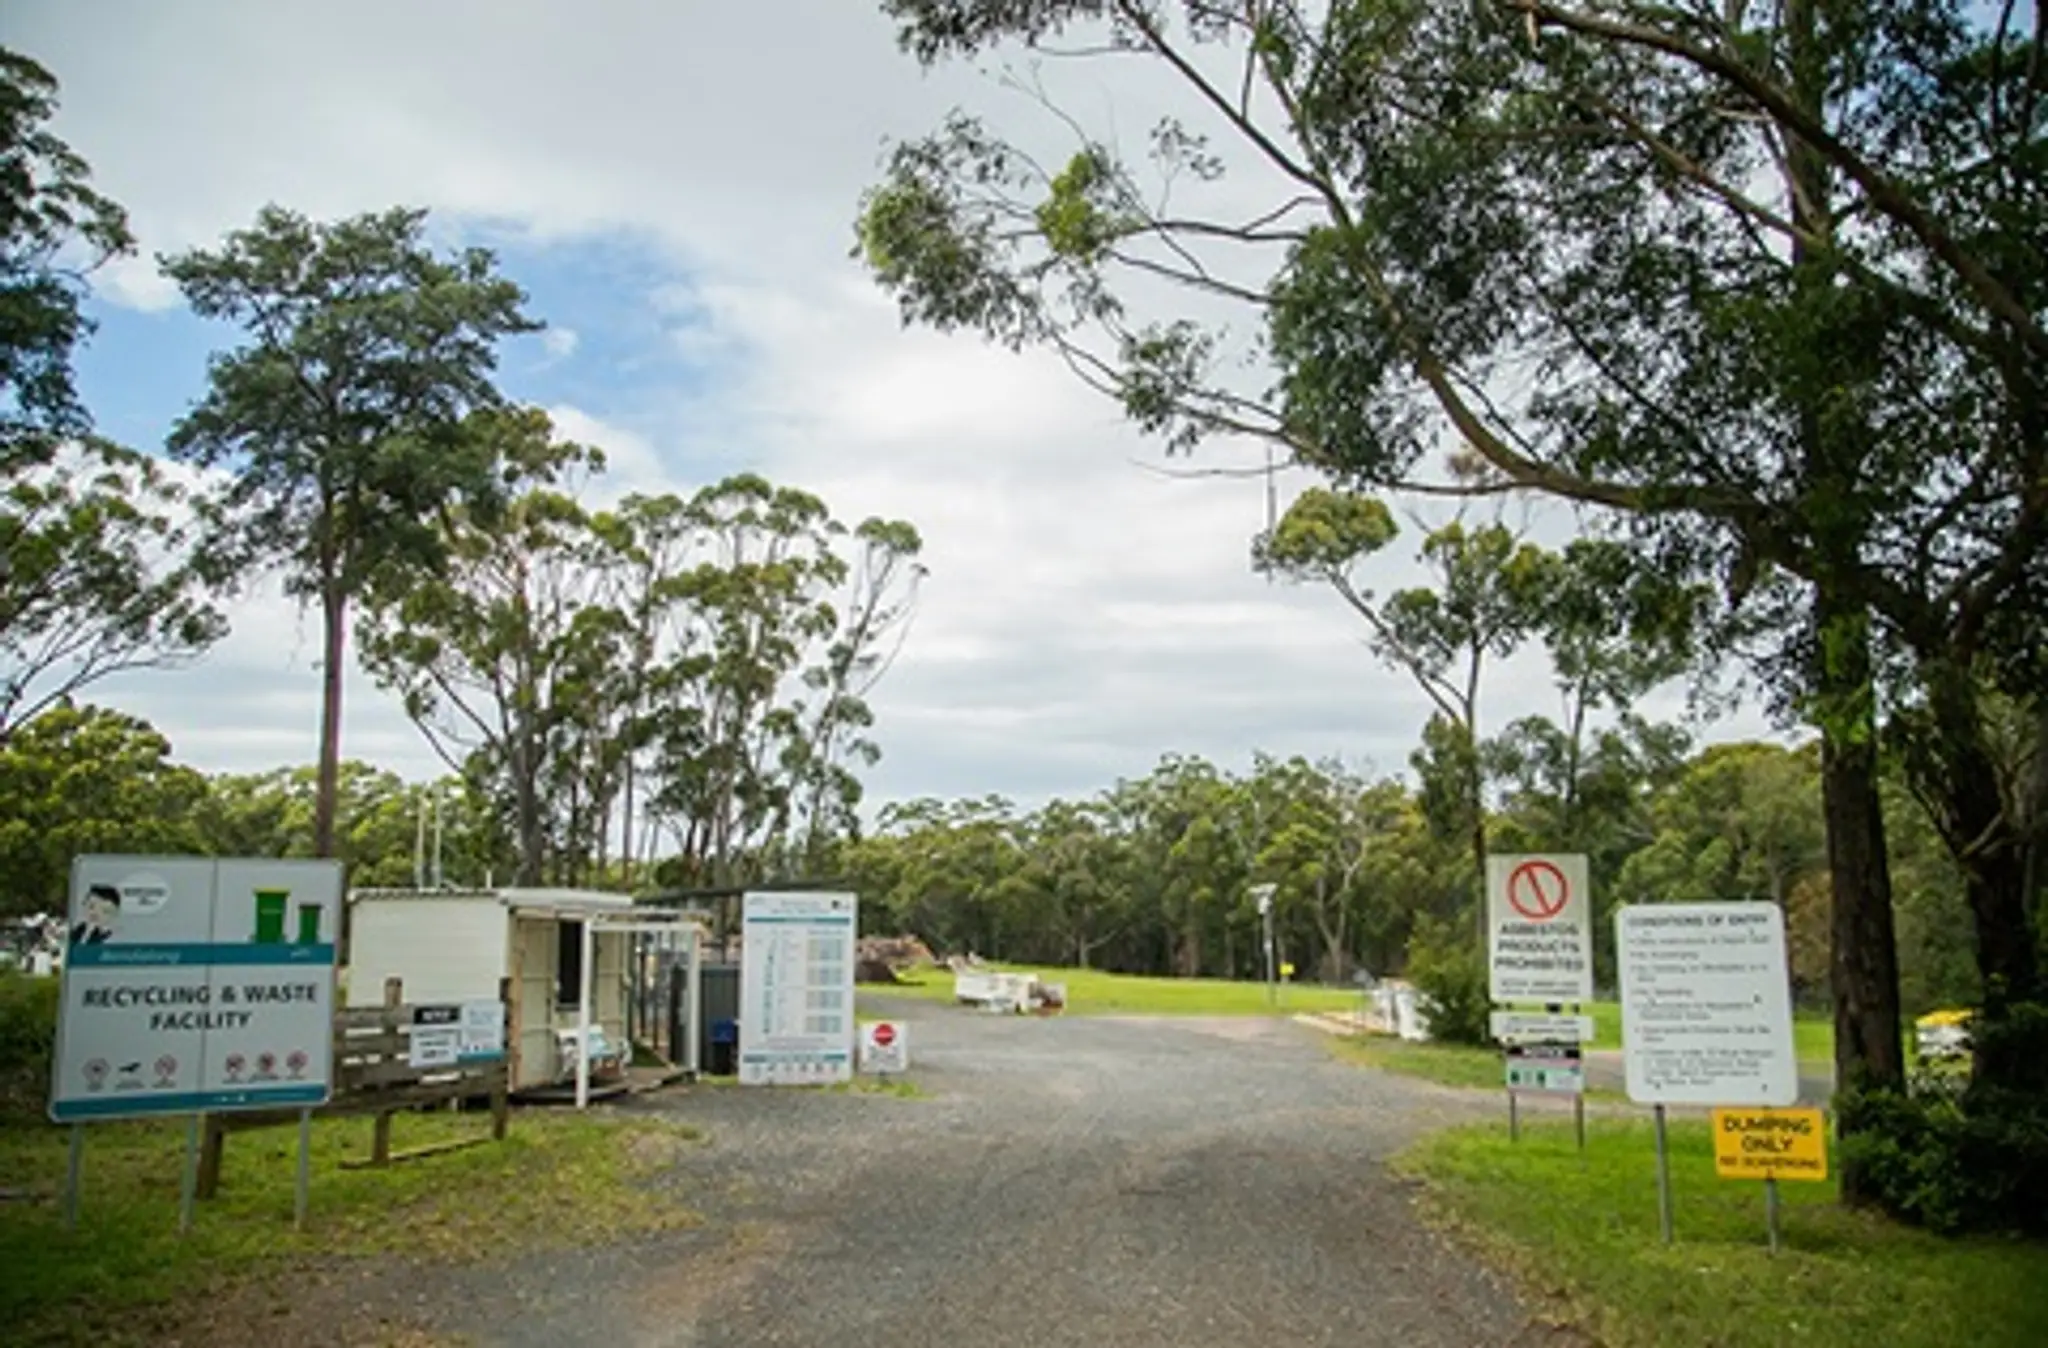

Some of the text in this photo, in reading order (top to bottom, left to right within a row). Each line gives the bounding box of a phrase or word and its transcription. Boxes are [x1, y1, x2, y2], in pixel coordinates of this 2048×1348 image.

[1628, 913, 1768, 927] CONDITIONS OF ENTRY
[1500, 922, 1580, 936] ASBESTOS
[1497, 938, 1580, 953] PRODUCTS
[1494, 956, 1584, 972] PROHIBITED
[82, 983, 319, 1008] RECYCLING & WASTE
[150, 1011, 252, 1031] FACILITY
[1723, 1115, 1814, 1135] DUMPING
[1741, 1134, 1793, 1153] ONLY
